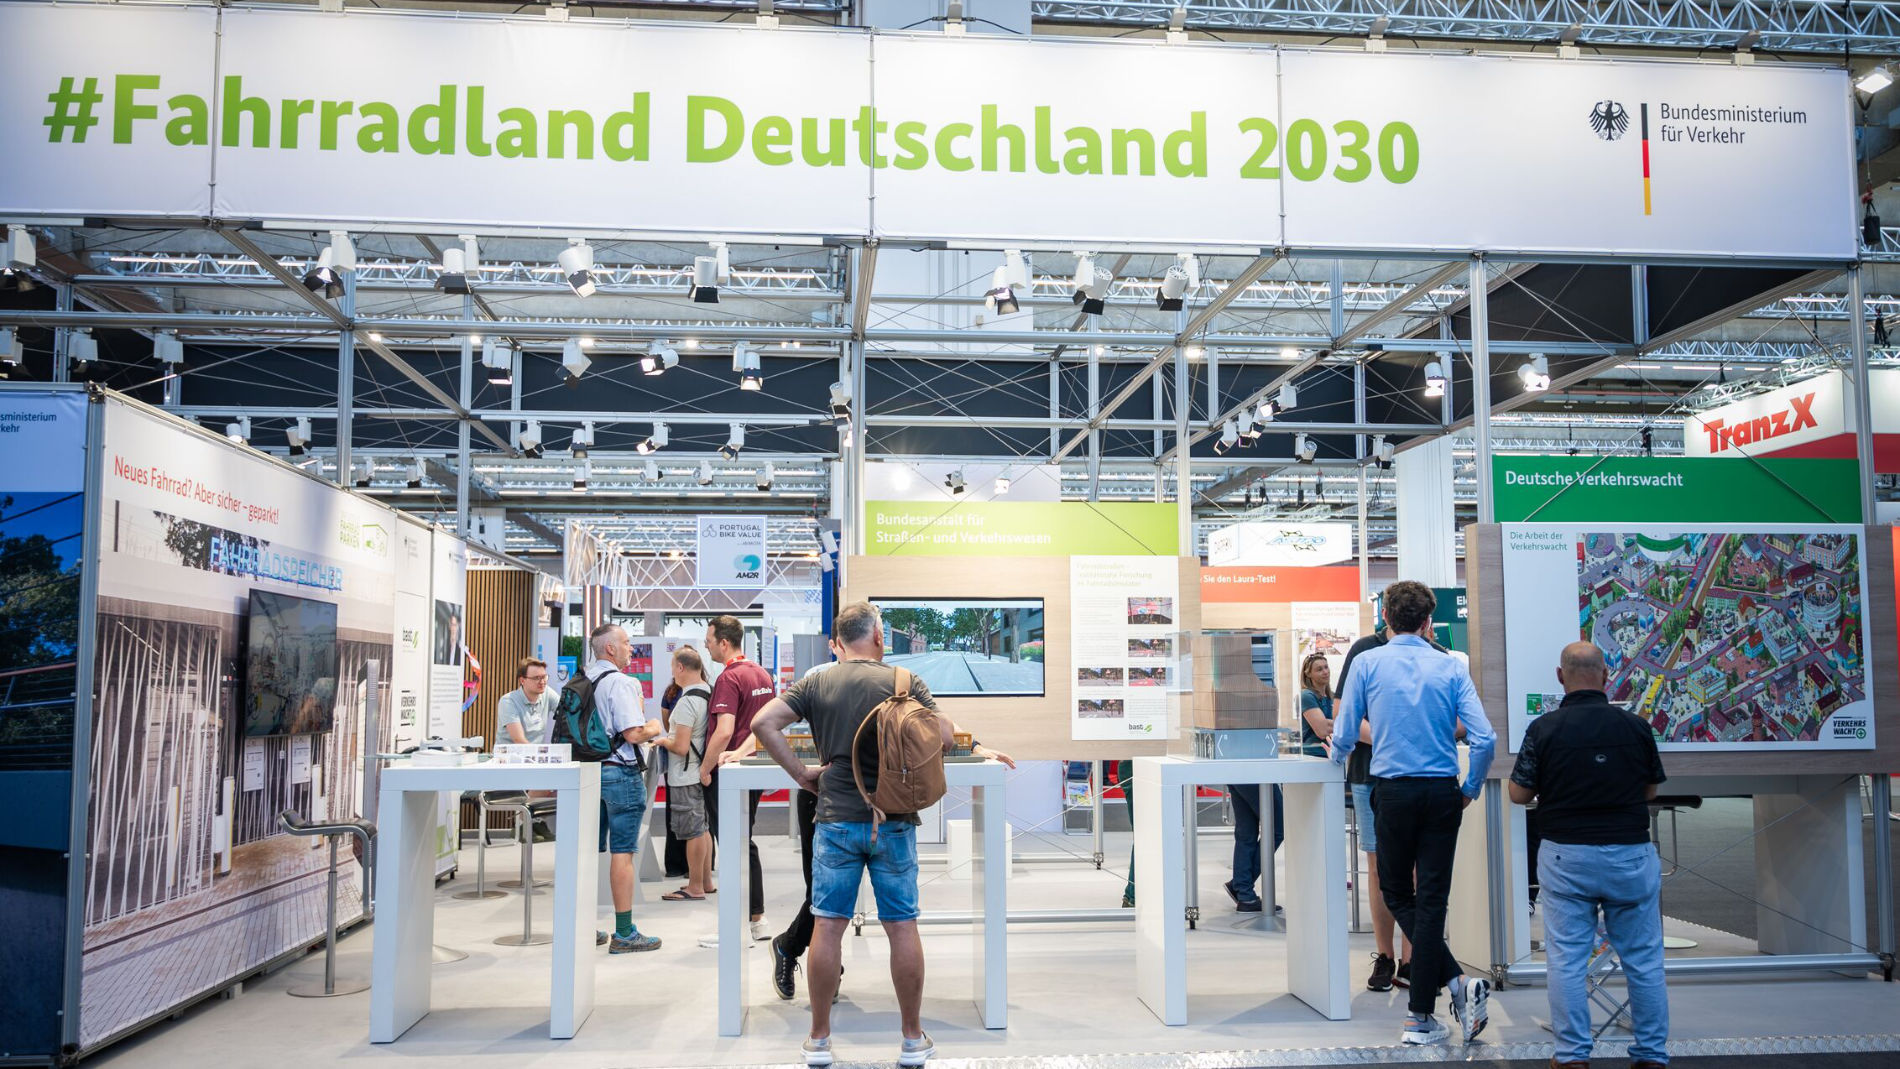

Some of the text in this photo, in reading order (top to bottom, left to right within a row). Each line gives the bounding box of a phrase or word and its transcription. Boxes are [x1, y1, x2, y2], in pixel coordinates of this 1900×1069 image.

[1660, 103, 1807, 124] Bundesministerium
[43, 74, 1420, 185] #Fahrradland Deutschland 2030
[1660, 125, 1746, 144] für Verkehr
[0, 423, 20, 433] kehr
[1703, 392, 1818, 454] TranzX
[1505, 470, 1684, 487] Deutsche Verkehrswacht
[114, 455, 148, 486] Neues
[150, 467, 192, 499] Fahrrad?
[195, 482, 215, 505] Aber
[217, 490, 242, 512] sicher
[248, 503, 279, 524] geparkt!
[876, 513, 985, 526] Bundesanstalt für
[876, 531, 1052, 545] Straßen- und Verkehrswesen
[1510, 531, 1563, 540] Die Arbeit der
[1510, 542, 1568, 551] Verkehrswacht
[210, 536, 343, 591] FAHRRADSPEICHER
[1203, 574, 1216, 583] Sie
[1217, 574, 1231, 583] den
[1233, 574, 1277, 583] Laura-Test!
[1128, 723, 1144, 731] bast
